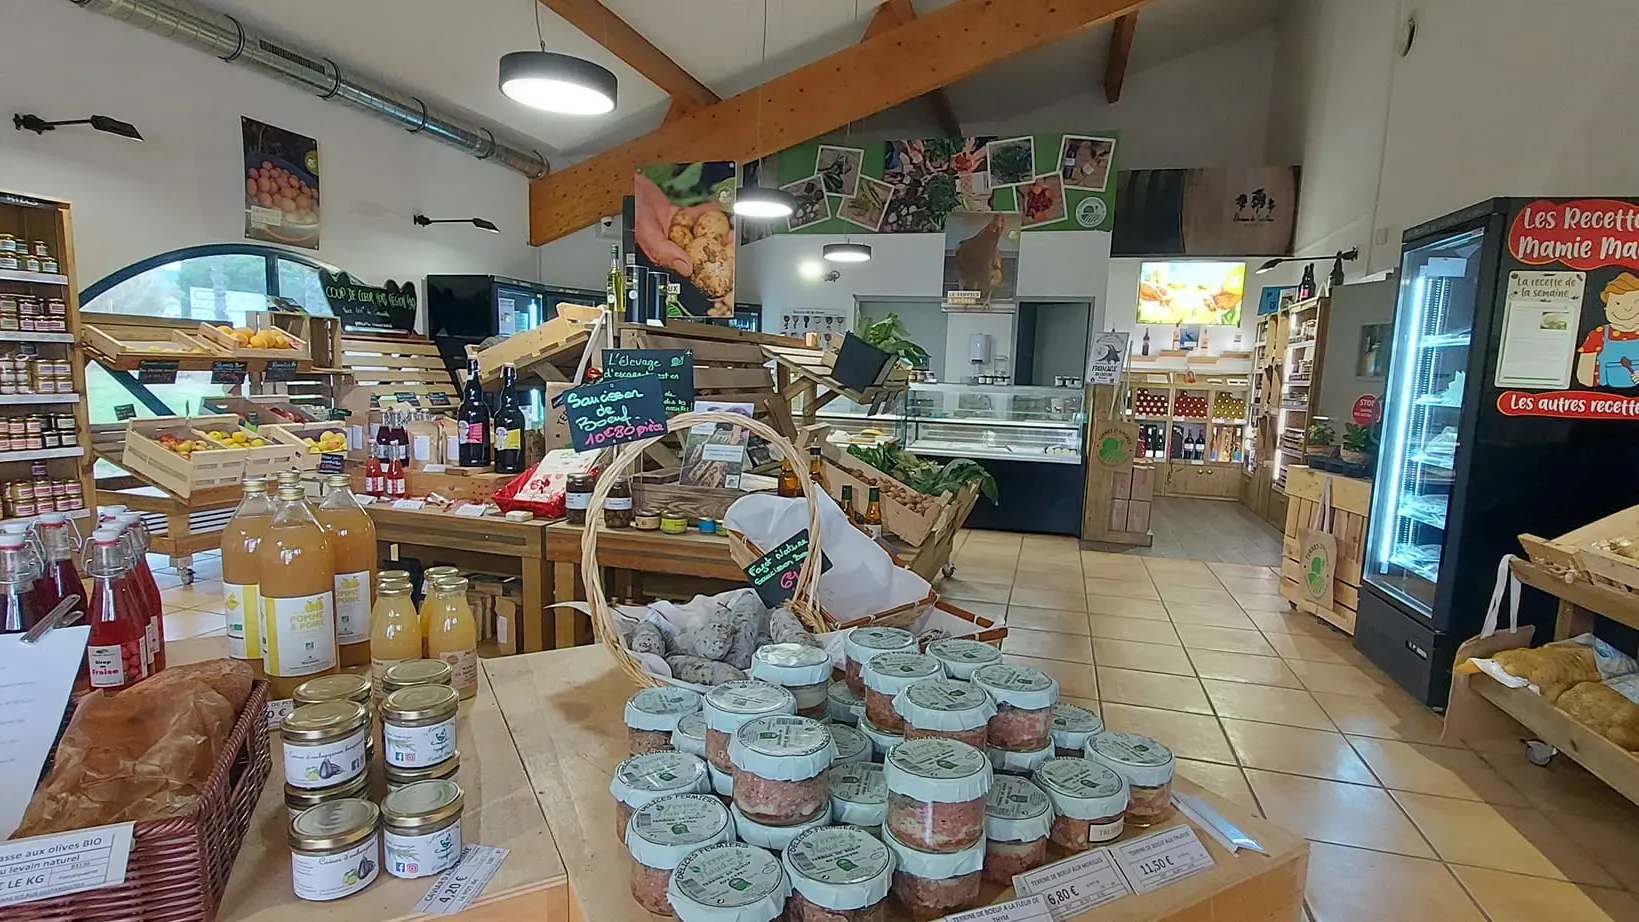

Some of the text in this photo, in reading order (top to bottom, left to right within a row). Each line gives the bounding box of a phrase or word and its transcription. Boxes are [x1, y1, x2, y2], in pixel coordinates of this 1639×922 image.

[1524, 207, 1556, 229] Les
[1518, 236, 1639, 259] Mamie Ma
[1517, 277, 1576, 288] La recette de
[1521, 287, 1569, 298] la semaine
[567, 388, 643, 408] Saucisson
[1511, 394, 1534, 410] Les
[1538, 397, 1586, 413] autres
[575, 405, 632, 431] Boeuf
[596, 404, 615, 416] de
[585, 425, 635, 445] 10€80
[754, 560, 793, 585] Saucisson
[290, 611, 324, 622] POMME
[300, 620, 324, 630] POIRE
[675, 794, 718, 806] FERMIERS
[25, 848, 46, 858] aux
[48, 842, 80, 853] olives
[82, 837, 102, 847] BIO
[9, 863, 41, 874] levain
[43, 854, 80, 866] naturel
[675, 852, 699, 880] DELICES
[699, 841, 749, 855] FERMIERS
[1140, 858, 1166, 875] 11,50
[1165, 855, 1174, 866] €
[7, 878, 23, 889] LE
[26, 874, 45, 885] KG
[437, 871, 468, 906] 4,20 €
[1047, 885, 1079, 905] 6,80 €
